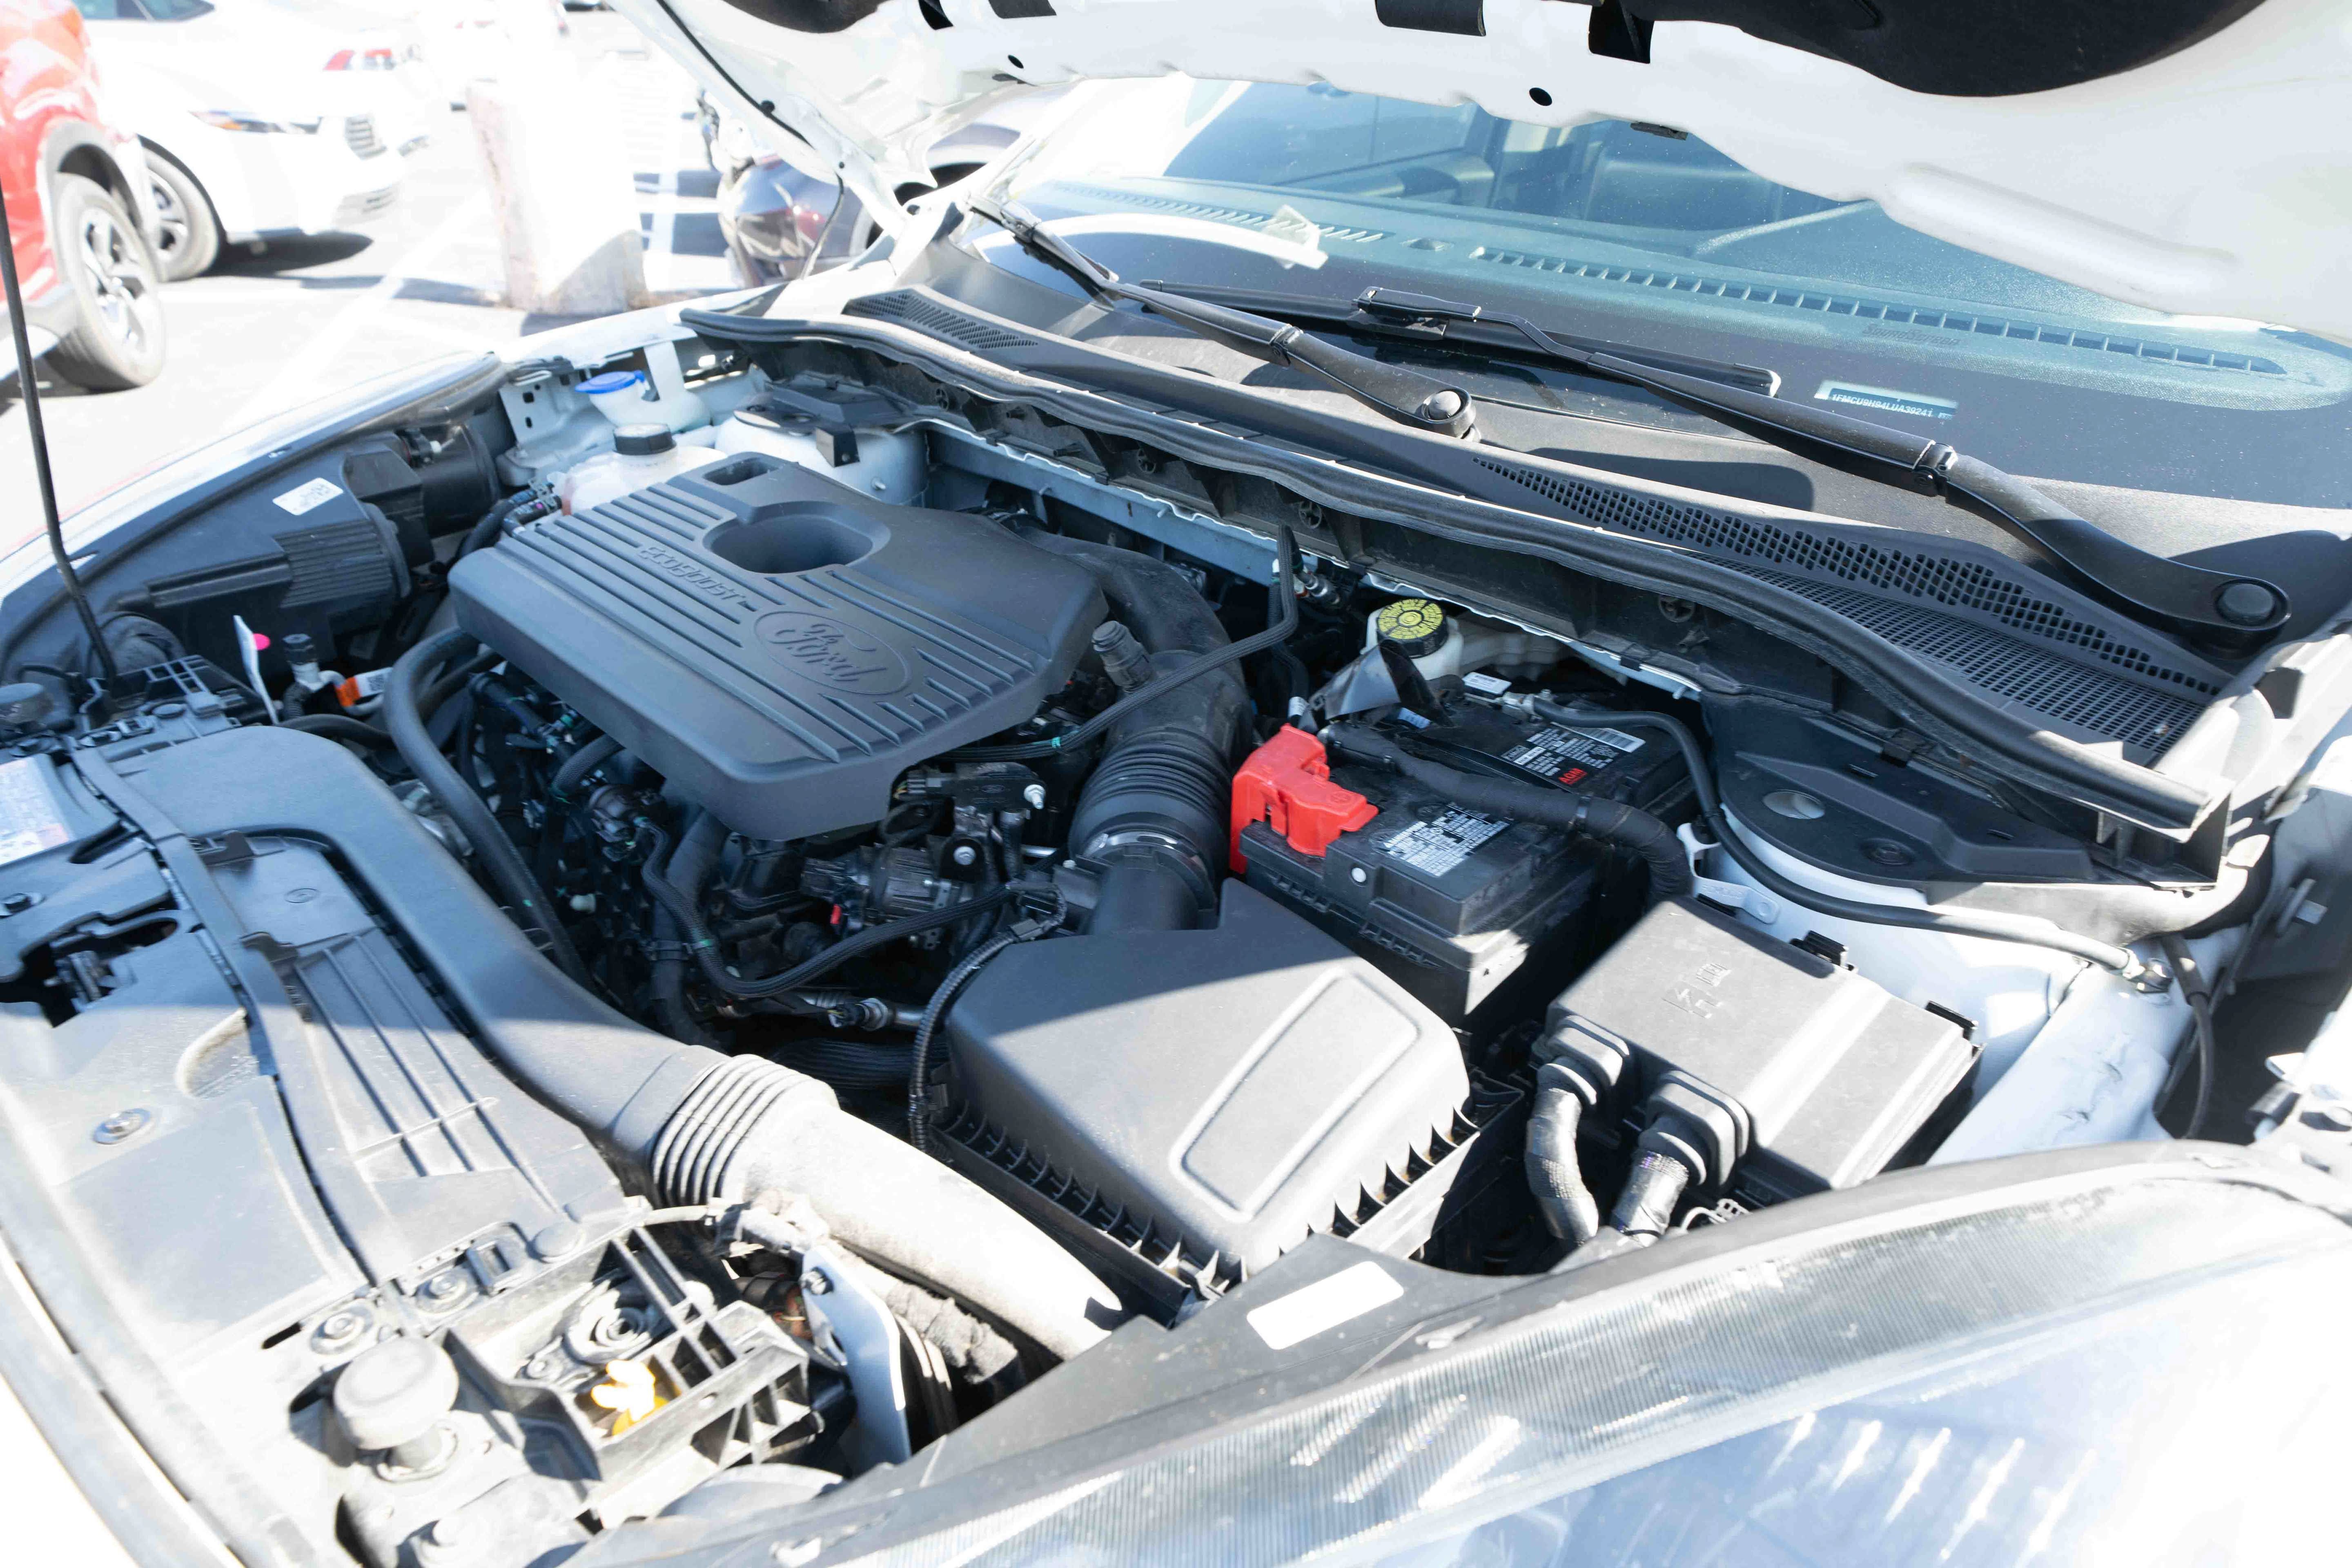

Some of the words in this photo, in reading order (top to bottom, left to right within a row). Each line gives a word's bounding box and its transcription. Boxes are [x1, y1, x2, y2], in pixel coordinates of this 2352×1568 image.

[1863, 323, 1960, 345] SoundScreen
[768, 623, 888, 682] Ford
[1558, 767, 1587, 784] AGM
